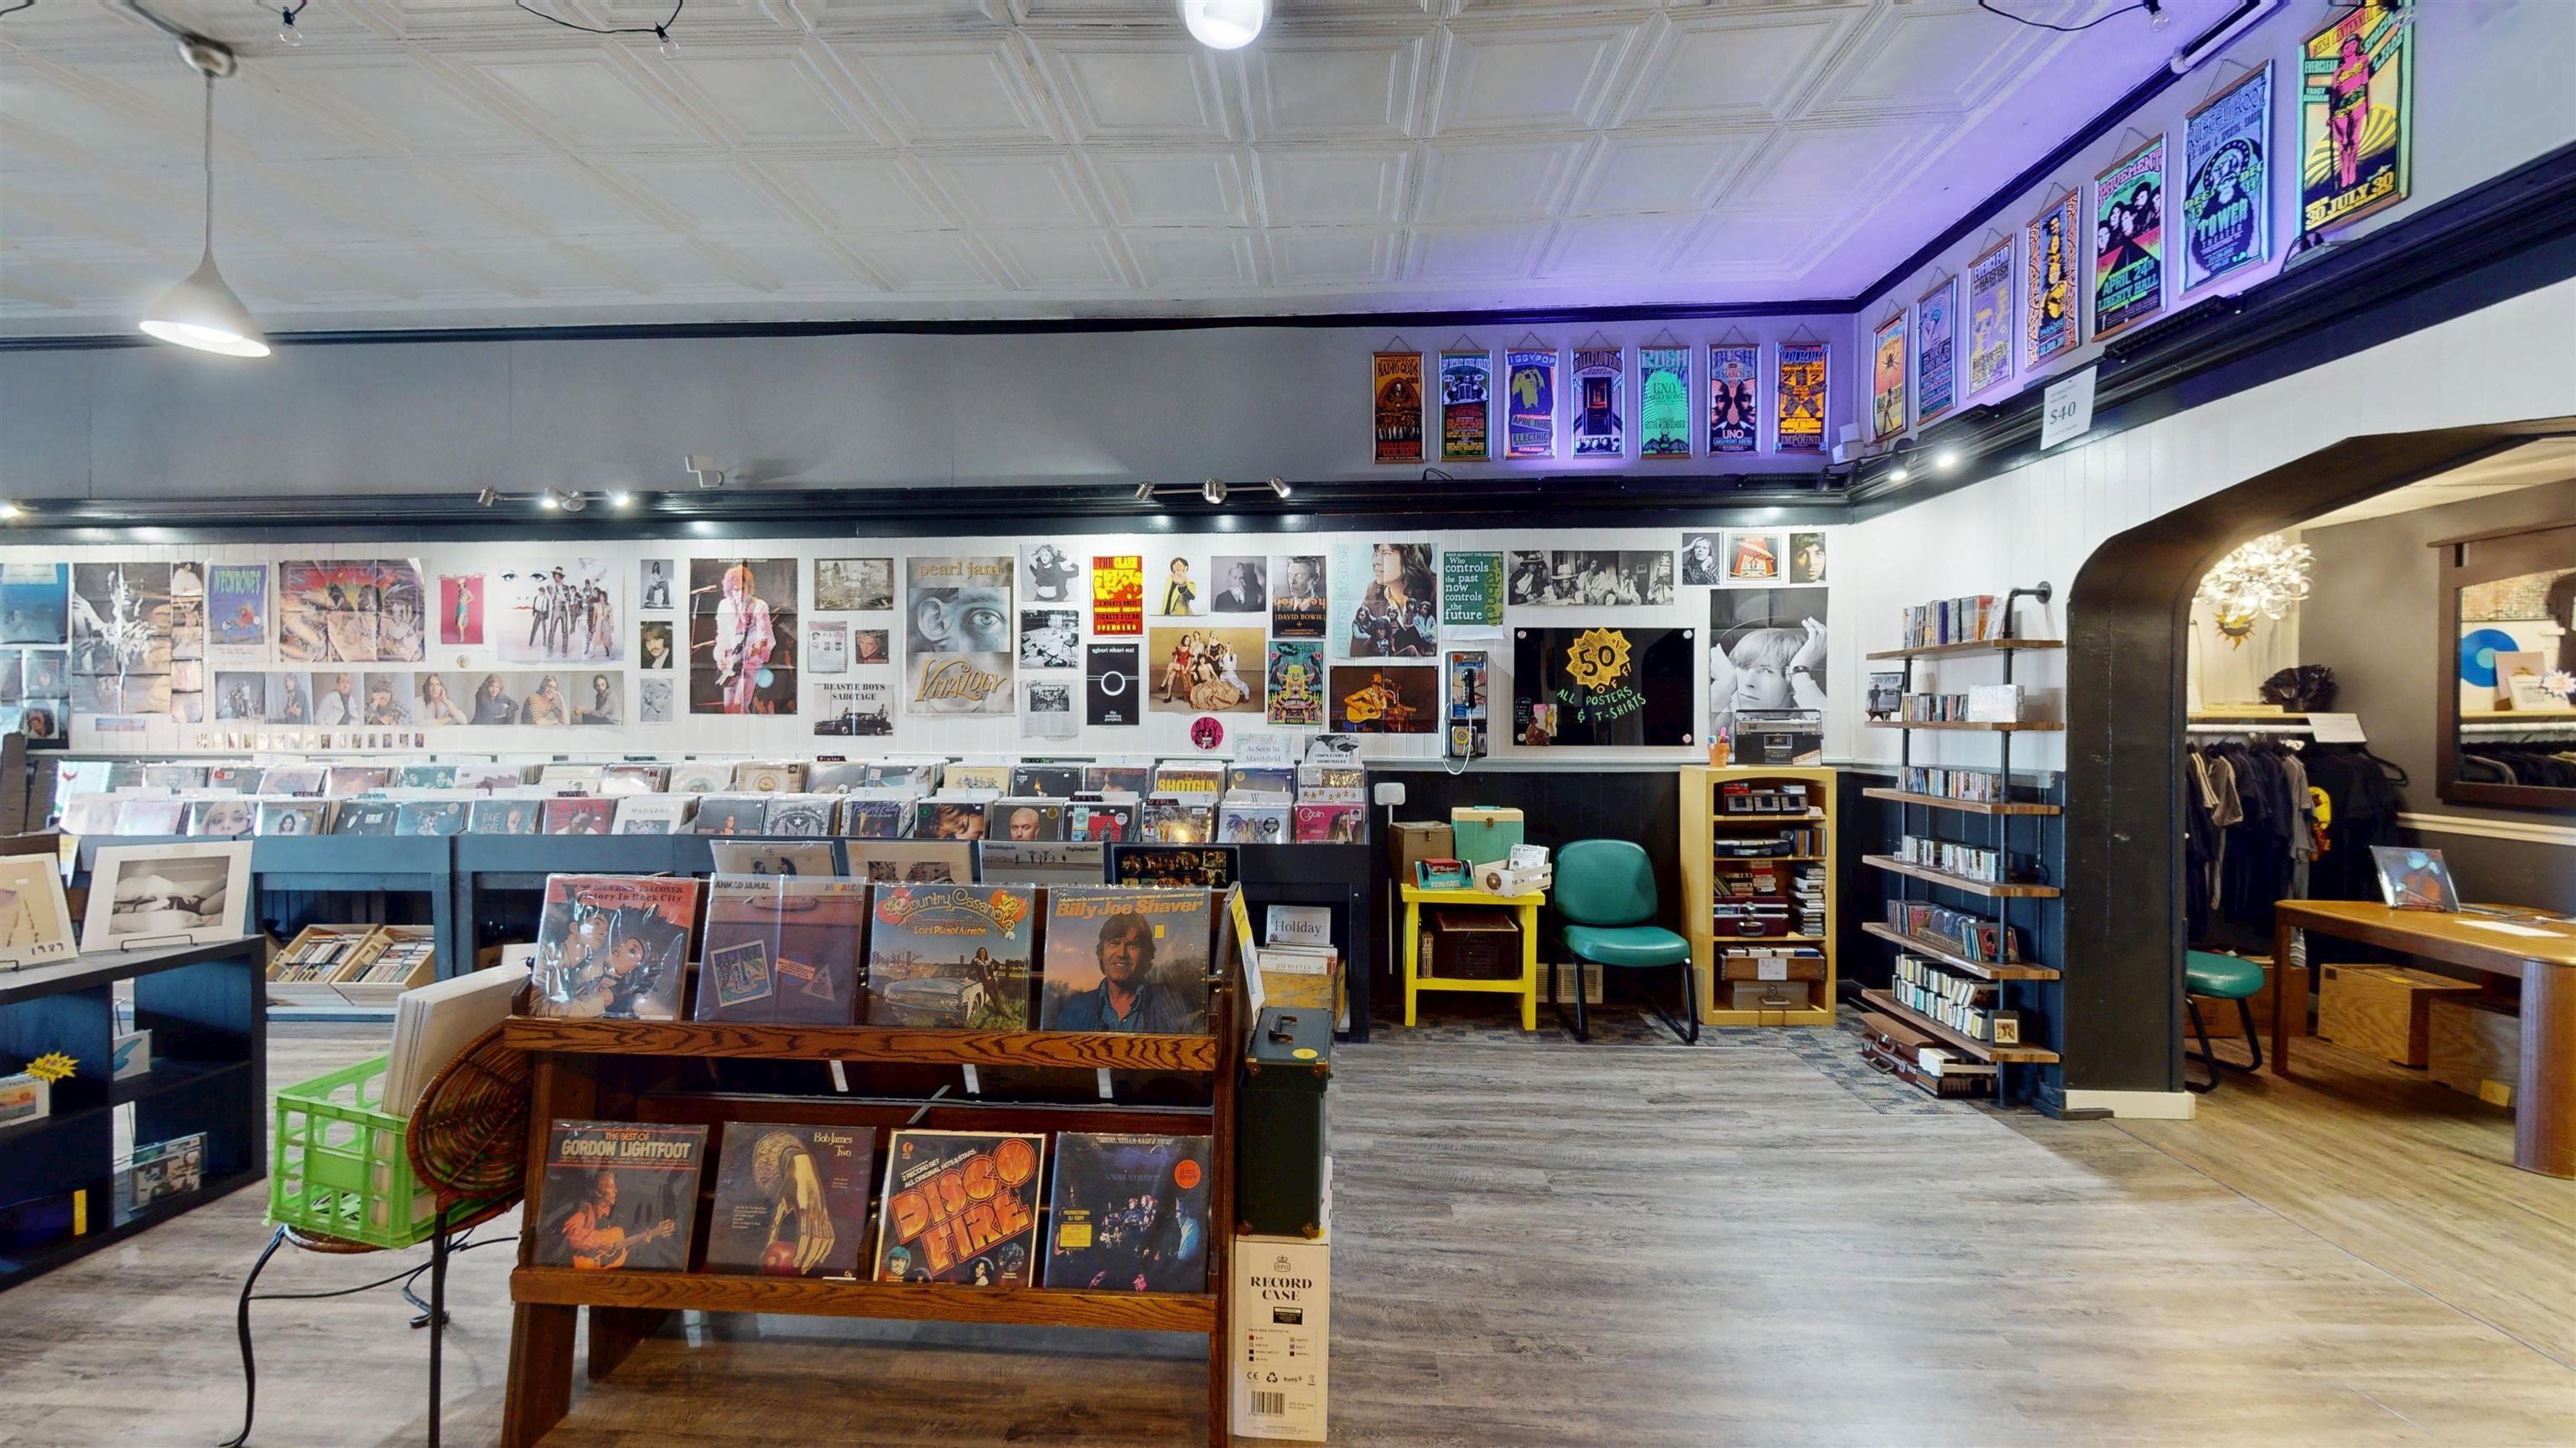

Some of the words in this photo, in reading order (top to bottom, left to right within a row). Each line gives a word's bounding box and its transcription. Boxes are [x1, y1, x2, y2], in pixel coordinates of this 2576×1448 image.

[2327, 183, 2370, 215] JULY
[2197, 197, 2249, 242] TOWER
[2102, 270, 2132, 297] APRIL
[1509, 353, 1535, 365] IGGY
[1535, 354, 1555, 365] POP
[1713, 350, 1754, 367] BUSH
[1722, 369, 1745, 377] MARCH
[2049, 401, 2076, 425] $40
[1512, 418, 1533, 427] APRIL
[1533, 419, 1551, 430] THIRD
[1514, 433, 1548, 443] ELECTRIC
[1722, 429, 1744, 439] UNO
[1781, 434, 1821, 445] IMPOUND
[918, 563, 963, 579] pearl
[966, 563, 1001, 579] jam
[1445, 560, 1489, 573] controls
[1458, 573, 1478, 584] past
[1445, 590, 1483, 602] controls
[1451, 602, 1462, 610] the
[1445, 607, 1483, 620] future
[915, 659, 1006, 703] VITALOGY
[832, 693, 877, 702] SABOTAGE
[1557, 688, 1575, 705] ALL
[1586, 686, 1633, 707] POSTERS
[1577, 708, 1586, 723] &
[1595, 693, 1647, 722] T-SHIRTS
[1158, 778, 1218, 792] SHOTGUN
[1251, 793, 1259, 803] W
[617, 893, 629, 901] In
[631, 893, 658, 901] Rock
[660, 894, 683, 903] City
[894, 891, 953, 916] Country
[952, 887, 1015, 931] Casanova
[1056, 901, 1098, 919] Billy
[1098, 900, 1133, 916] Joe
[1135, 897, 1205, 915] Shaver
[1275, 921, 1322, 937] Holiday
[605, 1132, 618, 1140] THE
[621, 1132, 638, 1141] BEST
[638, 1133, 650, 1141] OF
[813, 1133, 830, 1144] Bob
[829, 1133, 853, 1145] James
[561, 1139, 617, 1156] GORDON
[620, 1141, 692, 1159] LIGHTFOOT
[835, 1145, 852, 1157] Two
[905, 1179, 917, 1188] ALL
[915, 1167, 942, 1184] ORIGINAL
[941, 1160, 955, 1172] HITS
[958, 1149, 979, 1163] STARS
[906, 1163, 929, 1181] RECORD
[928, 1158, 940, 1169] SET
[889, 1139, 1036, 1245] DISCO
[920, 1187, 1035, 1277] FIRE
[1250, 1276, 1312, 1289] RECORD
[1262, 1290, 1301, 1301] CASE
